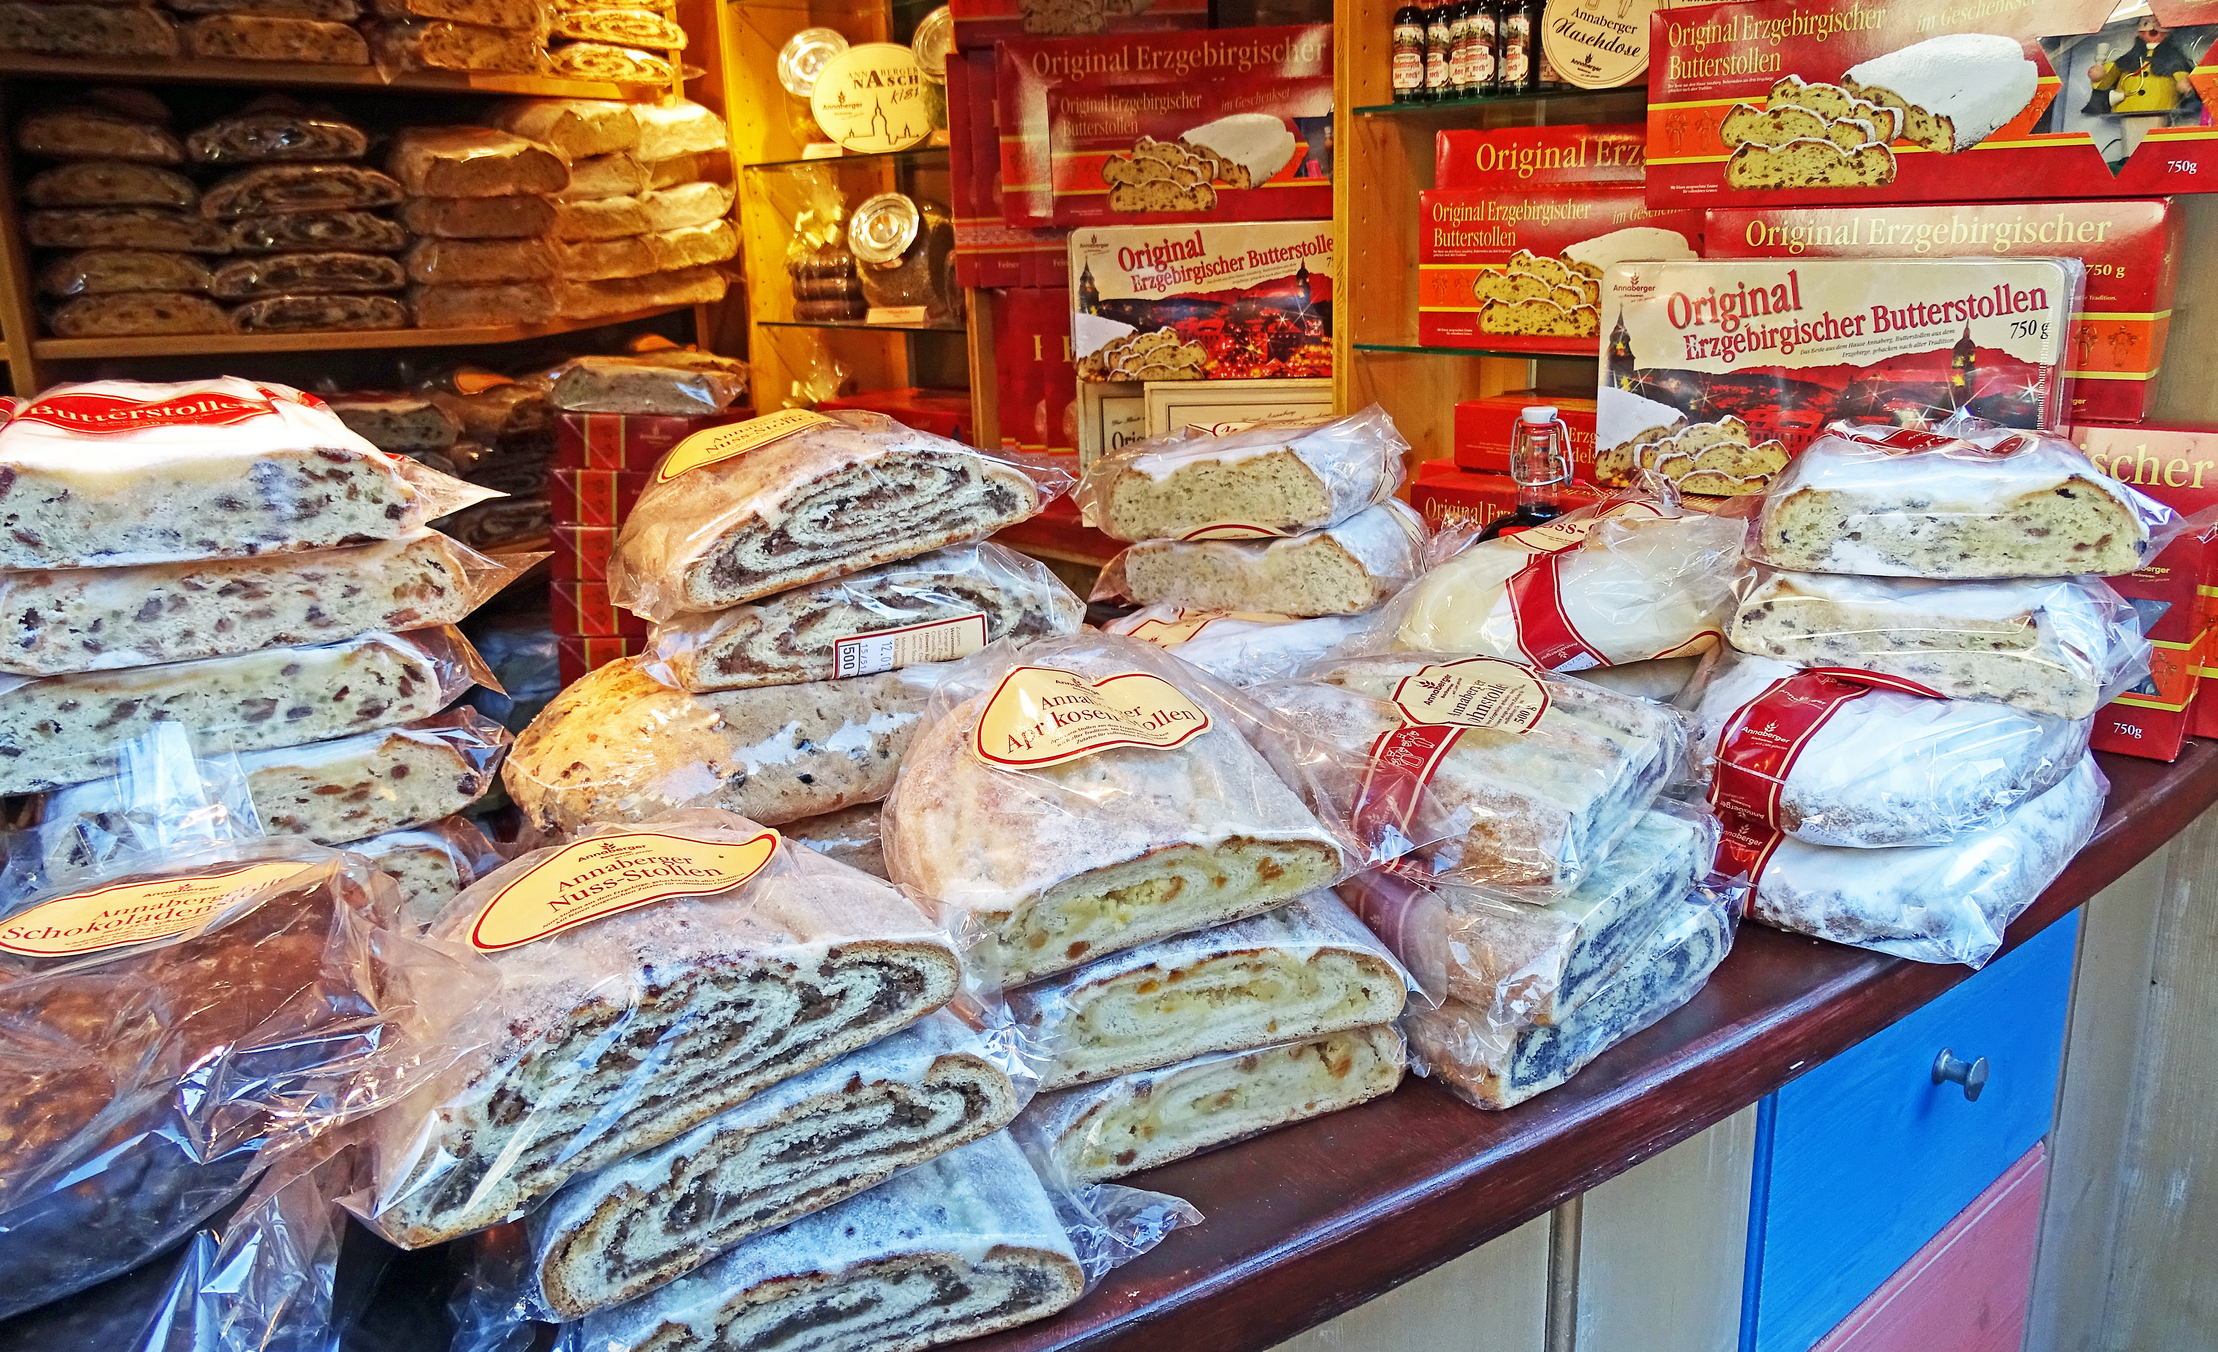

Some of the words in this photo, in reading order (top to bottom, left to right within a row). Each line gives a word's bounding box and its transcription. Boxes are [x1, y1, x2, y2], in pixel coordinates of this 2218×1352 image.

[1571, 7, 1638, 35] Annaberger
[1669, 15, 1738, 53] Original
[1742, 3, 1886, 47] Erzgebirgischer
[1552, 17, 1641, 58] Naschdose
[1032, 45, 1129, 82] Original
[1136, 36, 1326, 76] Erzgebirgischer
[1669, 46, 1781, 80] Butterstollen
[1060, 93, 1108, 116] Original
[1111, 91, 1203, 115] Erzgebirgischer
[1061, 119, 1138, 138] Butterstollen
[1476, 137, 1587, 179] Original
[1594, 138, 1646, 175] Erz
[2167, 160, 2197, 174] 750g
[1432, 200, 1485, 228] Original
[1488, 198, 1592, 227] Erzgebirgischer
[1612, 209, 1627, 225] im
[1433, 226, 1516, 248] Butterstollen
[1745, 218, 1859, 254] Original
[1867, 212, 2113, 253] Erzgebirgischer
[1118, 229, 1206, 272] Original
[1131, 254, 1246, 293] Erzgebirgischer
[1247, 234, 1334, 269] Butterstolle
[1613, 284, 1656, 292] Annaberger
[1667, 269, 1803, 333] Original
[1683, 311, 1866, 364] Erzgebirgischer
[1871, 283, 2049, 334] Butterstollen
[2010, 319, 2037, 339] 750
[843, 646, 855, 670] 500
[1514, 709, 1531, 724] 500
[1741, 726, 1791, 743] Annaberger
[2113, 722, 2143, 739] 750g
[1723, 830, 1763, 847] nnaberger
[578, 845, 646, 862] Annaberger
[559, 856, 692, 893] Annaberger
[143, 885, 221, 898] Annaberger
[546, 865, 725, 913] Nuss-Stollen
